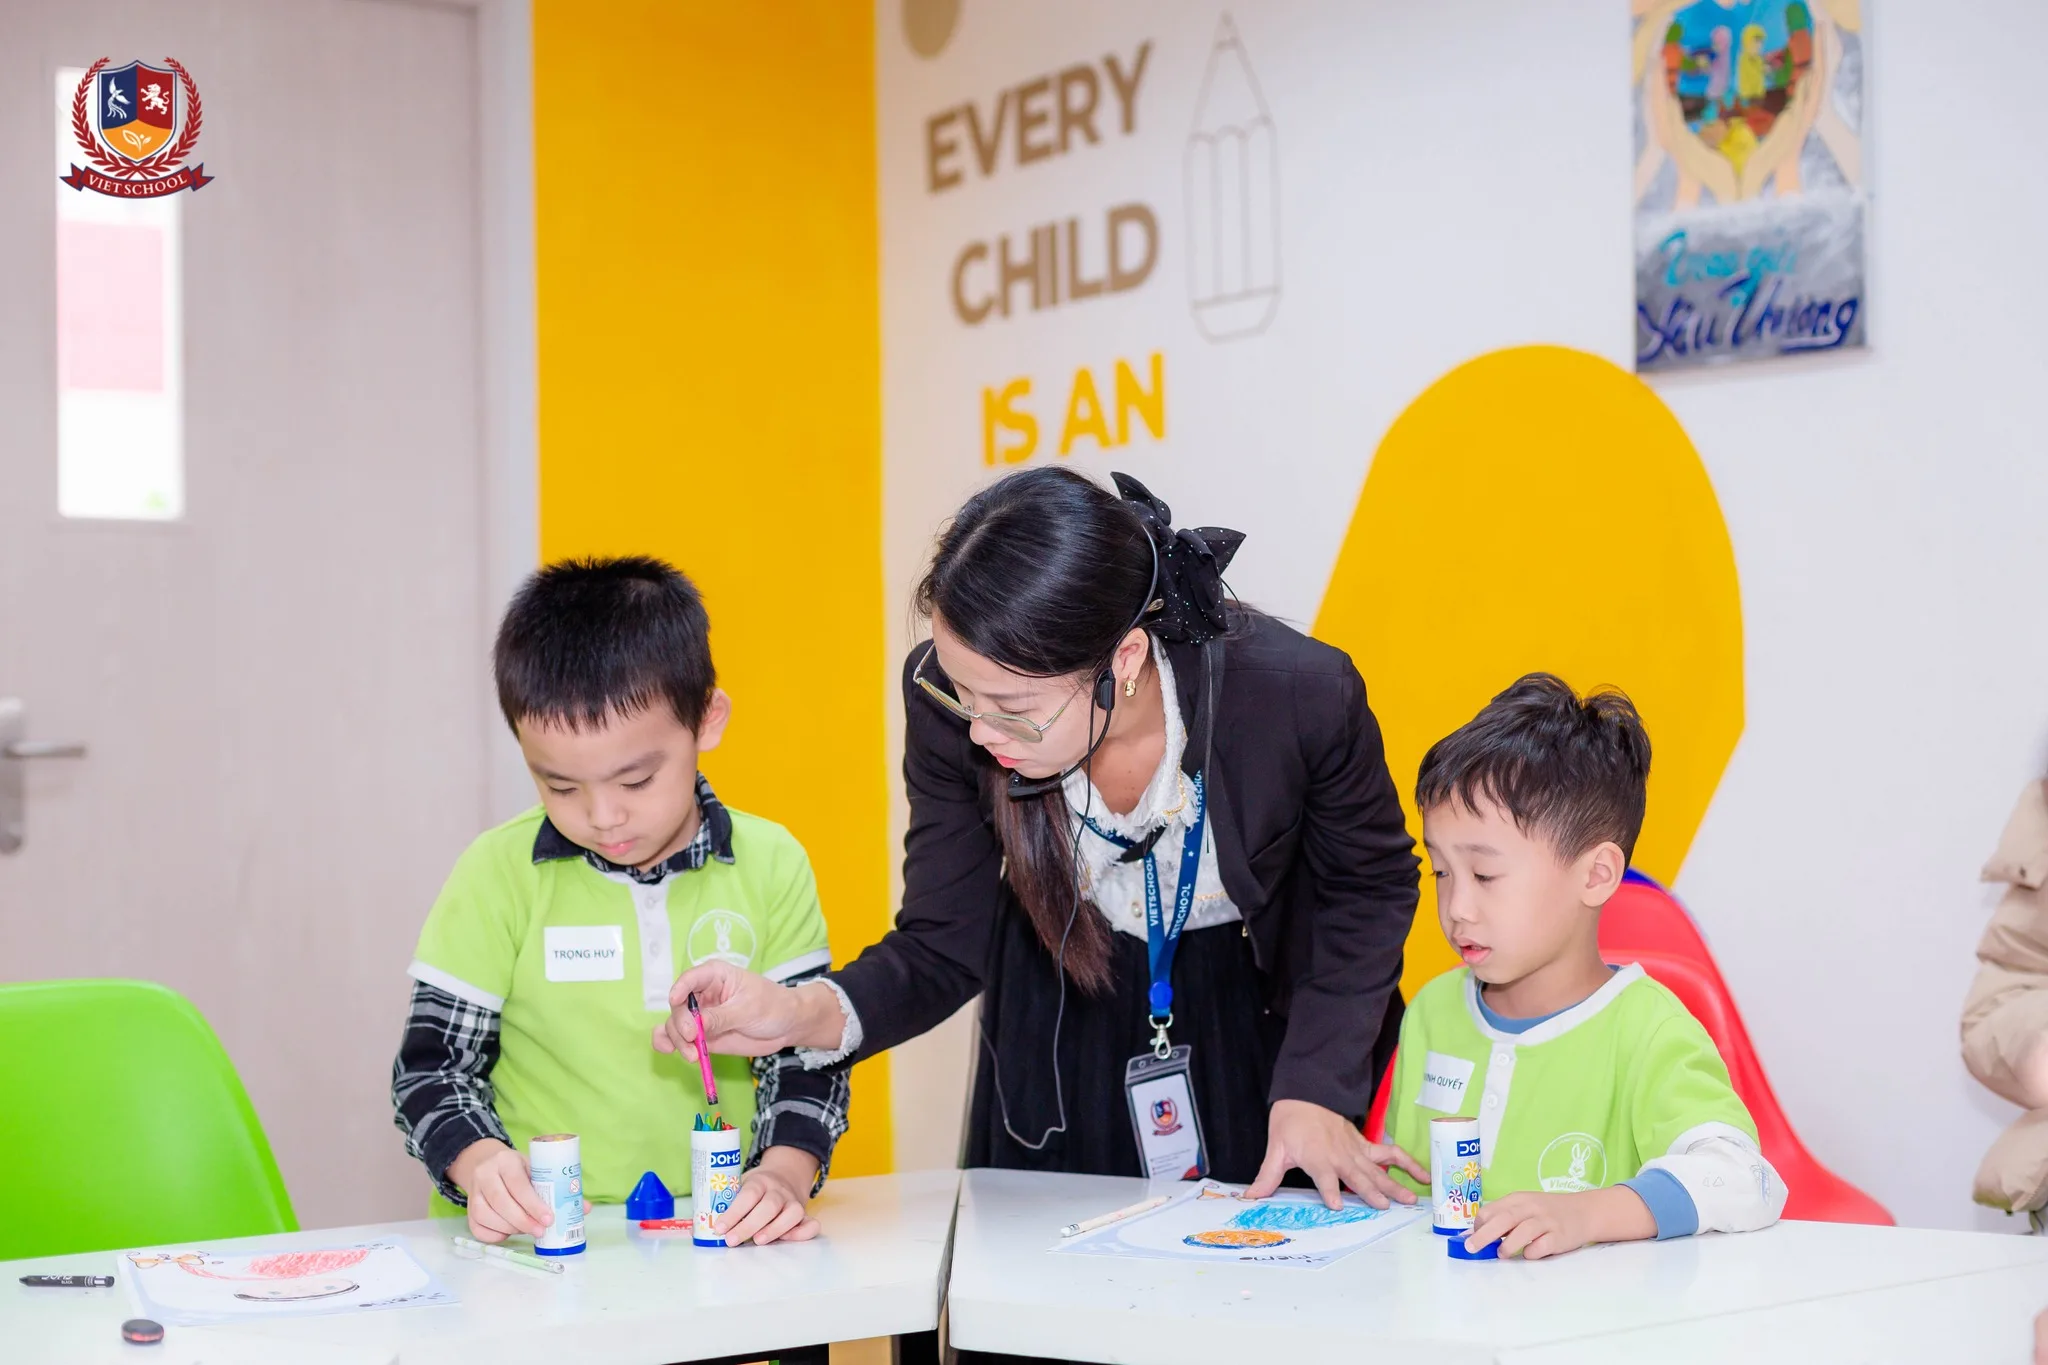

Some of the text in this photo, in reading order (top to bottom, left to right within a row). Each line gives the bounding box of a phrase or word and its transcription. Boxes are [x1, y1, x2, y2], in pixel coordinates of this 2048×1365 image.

[925, 37, 1153, 194] EVERY
[951, 202, 1160, 325] CHILD
[982, 352, 1164, 467] IS AN
[1146, 857, 1159, 927] VIETSCHOOL
[1169, 883, 1191, 941] VIETSCHOOL
[593, 948, 615, 959] HUY
[711, 1151, 740, 1166] DOMS
[717, 1203, 726, 1211] 12
